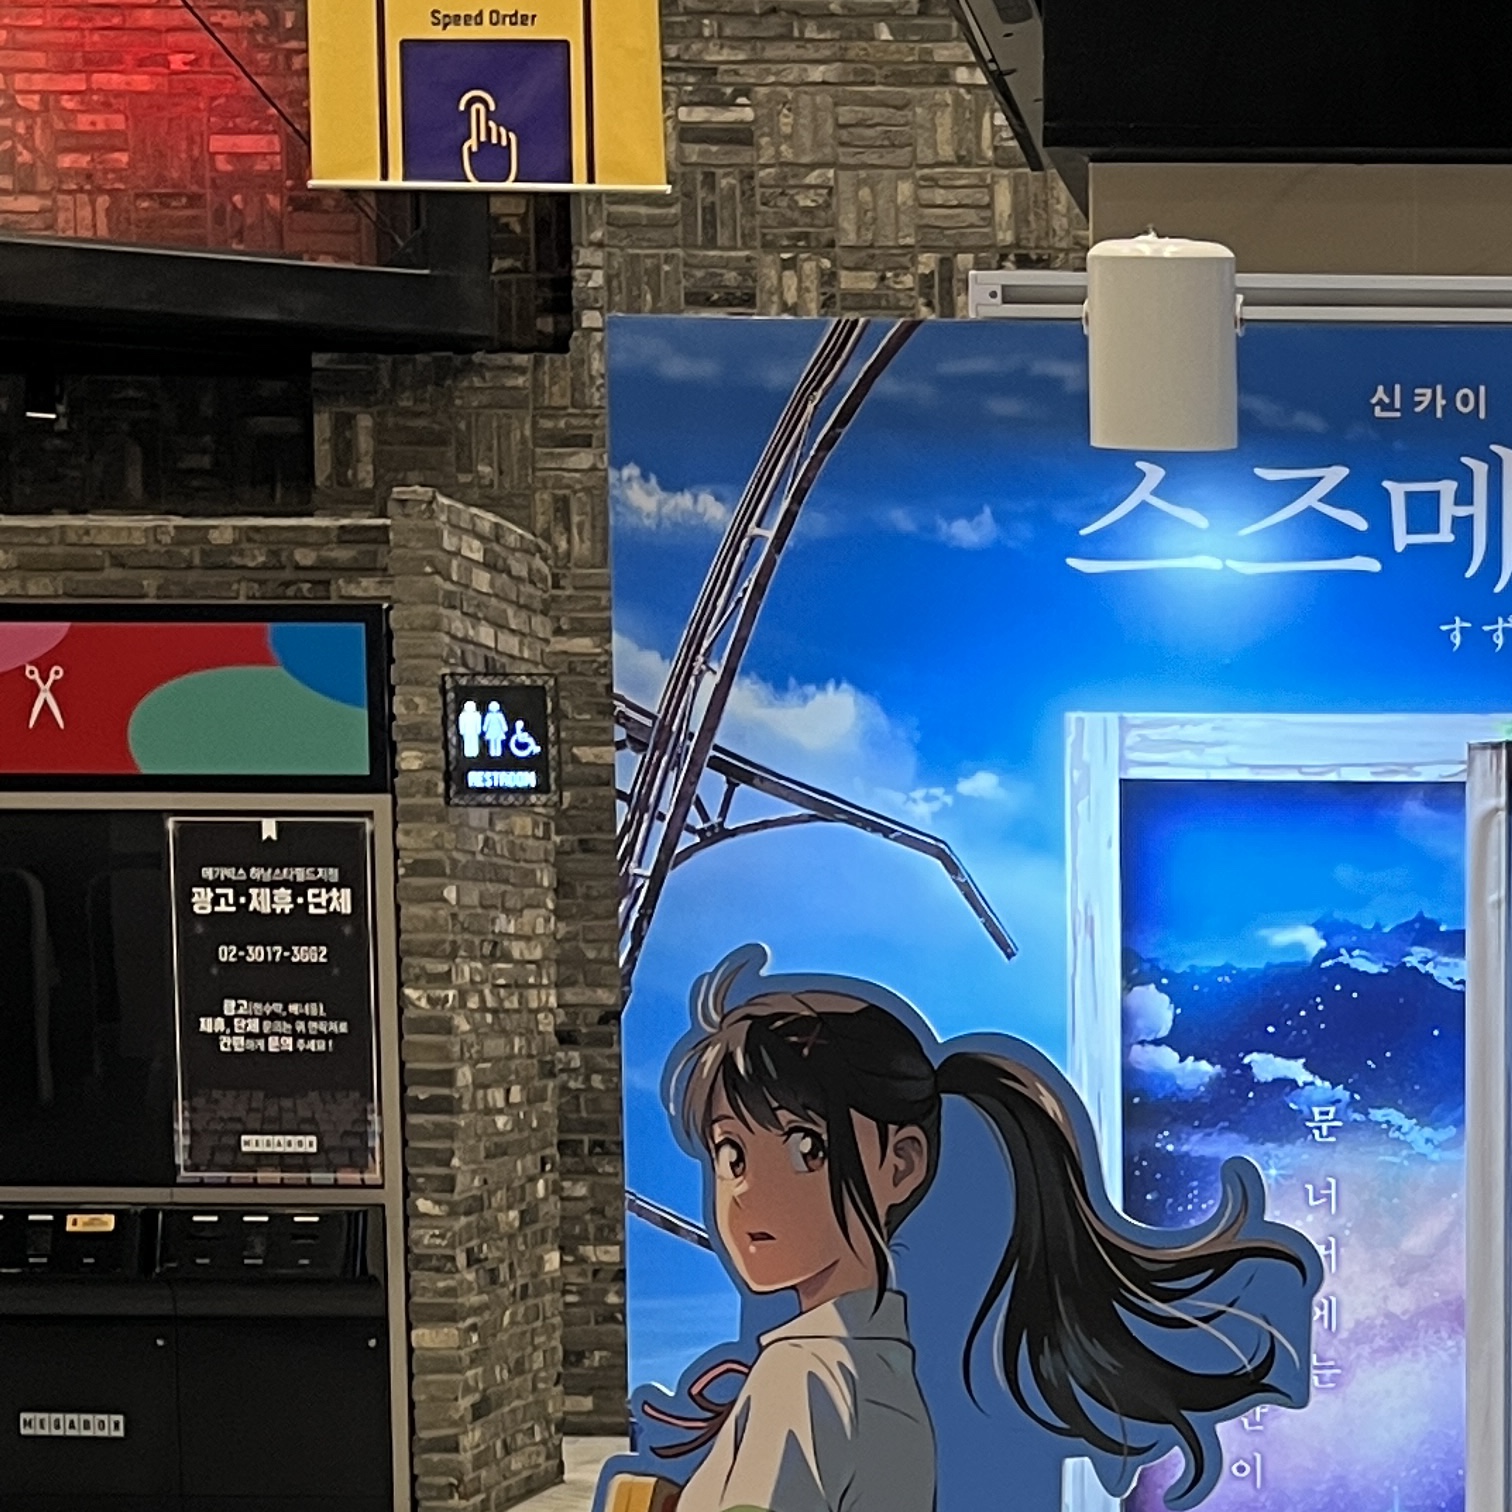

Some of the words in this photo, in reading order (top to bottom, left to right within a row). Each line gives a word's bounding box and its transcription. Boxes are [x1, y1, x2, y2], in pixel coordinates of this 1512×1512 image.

[430, 9, 483, 30] Speed
[489, 9, 537, 26] Order
[1370, 384, 1487, 420] 신카이
[1305, 1106, 1343, 1141] 문
[21, 1414, 123, 1435] MEGABOX
